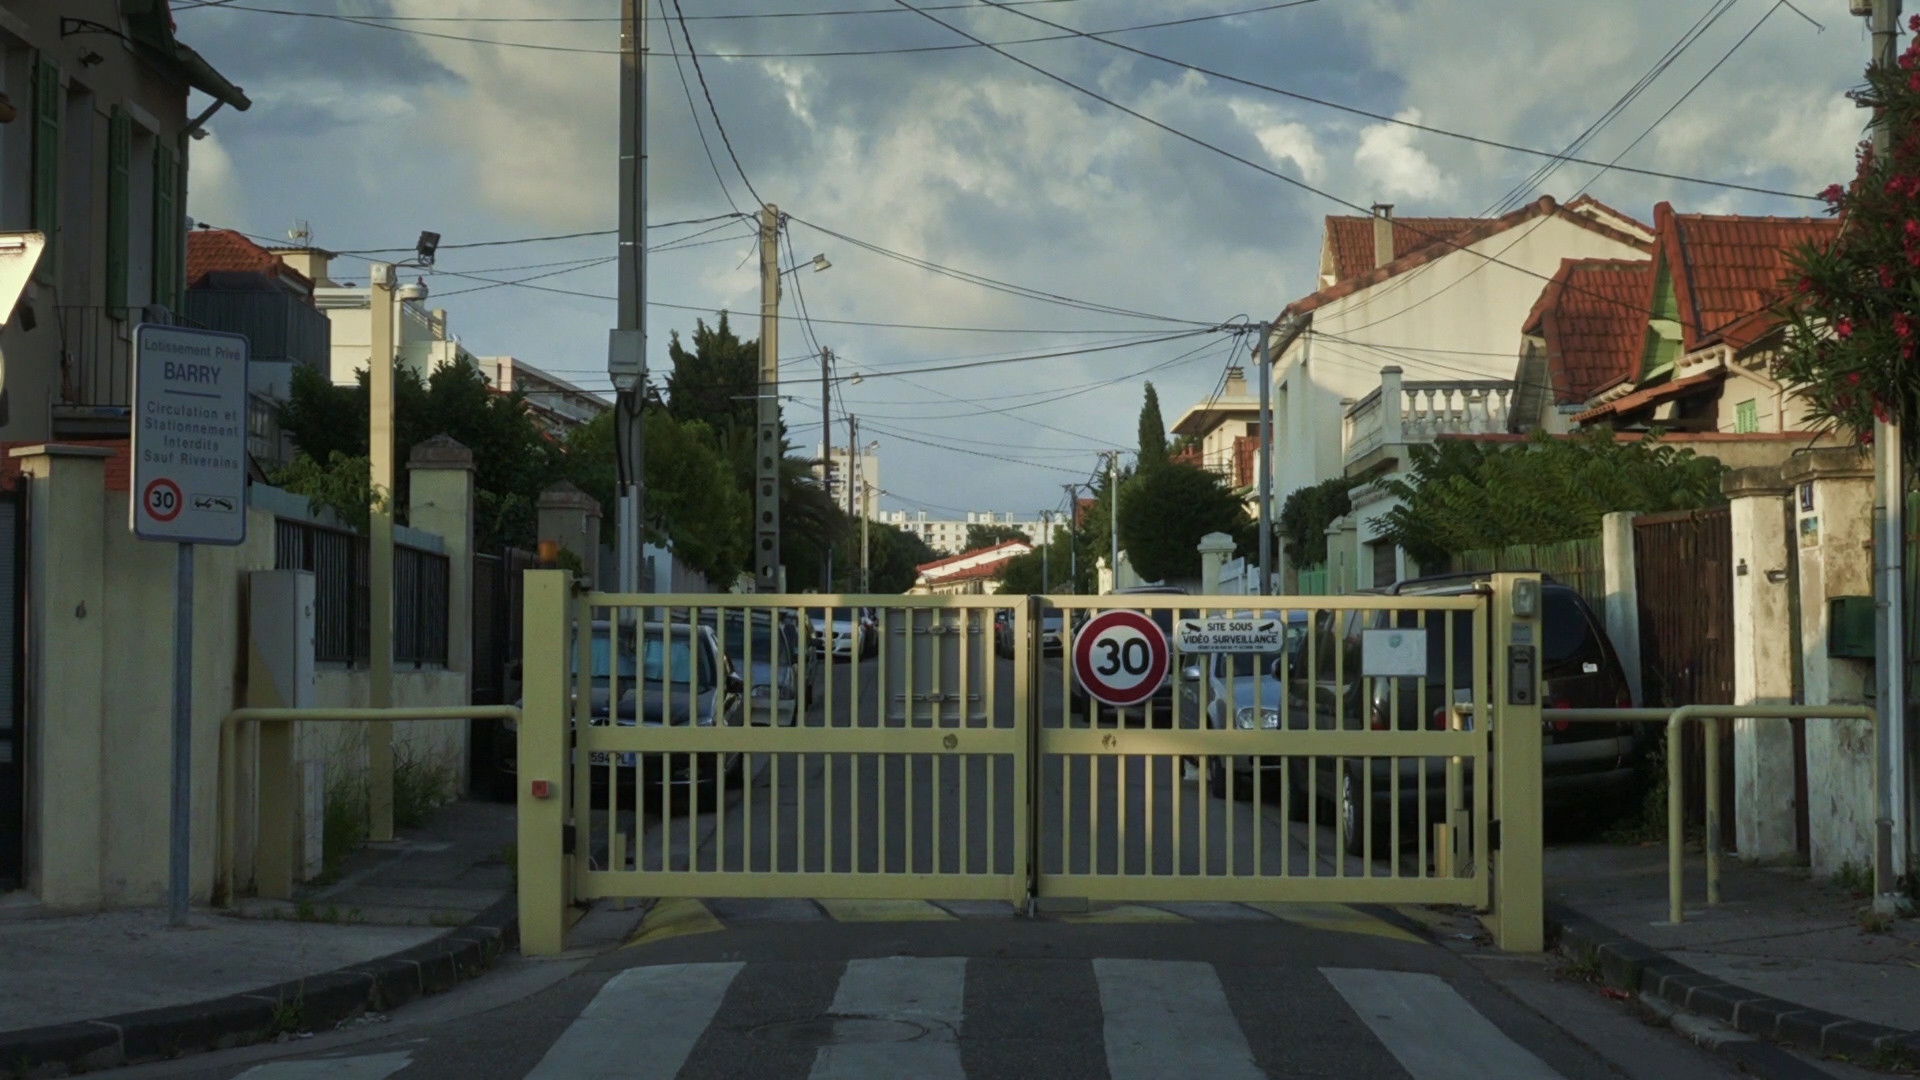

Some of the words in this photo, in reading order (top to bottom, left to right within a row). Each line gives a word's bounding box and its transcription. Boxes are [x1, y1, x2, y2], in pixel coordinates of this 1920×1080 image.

[144, 337, 211, 356] Lotissement
[164, 361, 222, 385] BARRY
[147, 401, 219, 418] Circulation
[224, 409, 238, 420] et
[144, 417, 239, 437] Stationnement
[164, 434, 219, 452] Interdits
[144, 448, 174, 463] Sauf
[180, 452, 239, 470] Riverains
[152, 490, 175, 509] 30
[1207, 622, 1226, 632] SITE
[1229, 622, 1253, 632] SOUS
[1182, 633, 1210, 645] VIDÉO
[1212, 634, 1278, 645] SURVEILLANCE
[1096, 637, 1150, 676] 30
